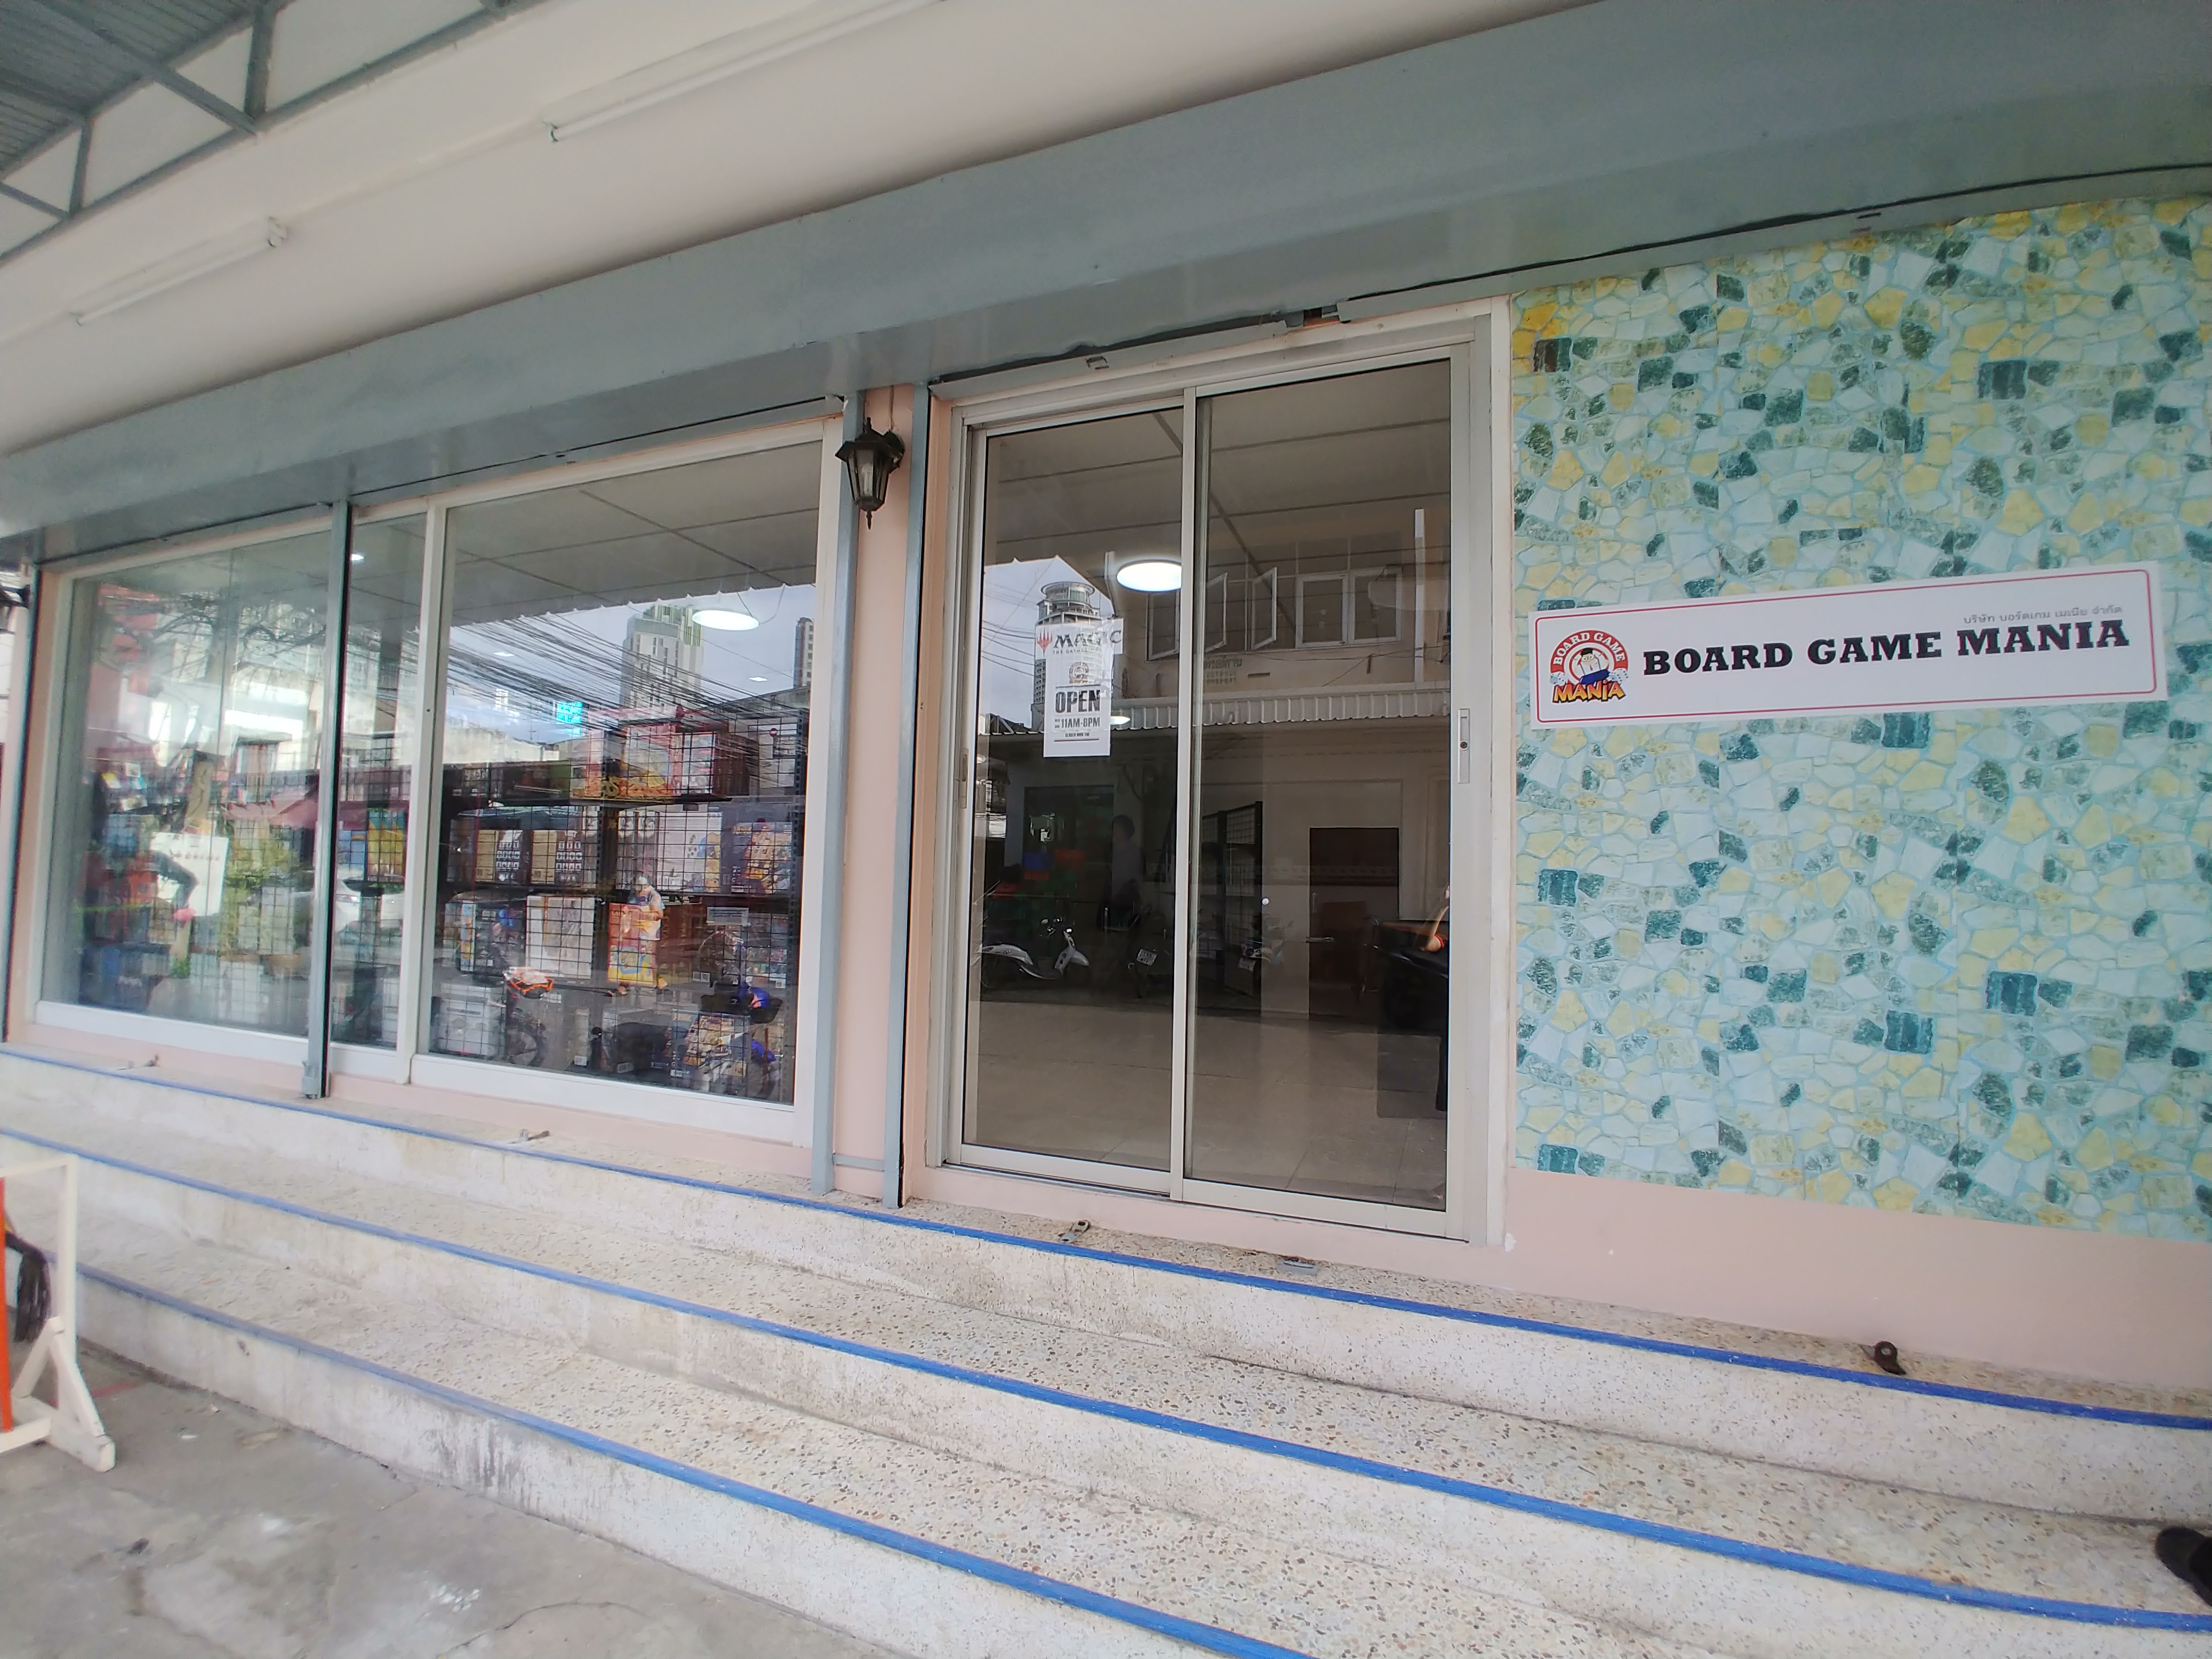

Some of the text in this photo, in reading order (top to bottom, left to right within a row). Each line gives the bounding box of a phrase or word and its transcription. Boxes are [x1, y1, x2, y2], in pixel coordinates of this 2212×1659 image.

[1964, 614, 1995, 624] บริษัท
[1553, 632, 1626, 666] BOARD GAME
[1643, 619, 2129, 676] BOARD GAME MANIA
[1055, 690, 1101, 714] OPEN
[1061, 717, 1100, 728] 11AM-8PM
